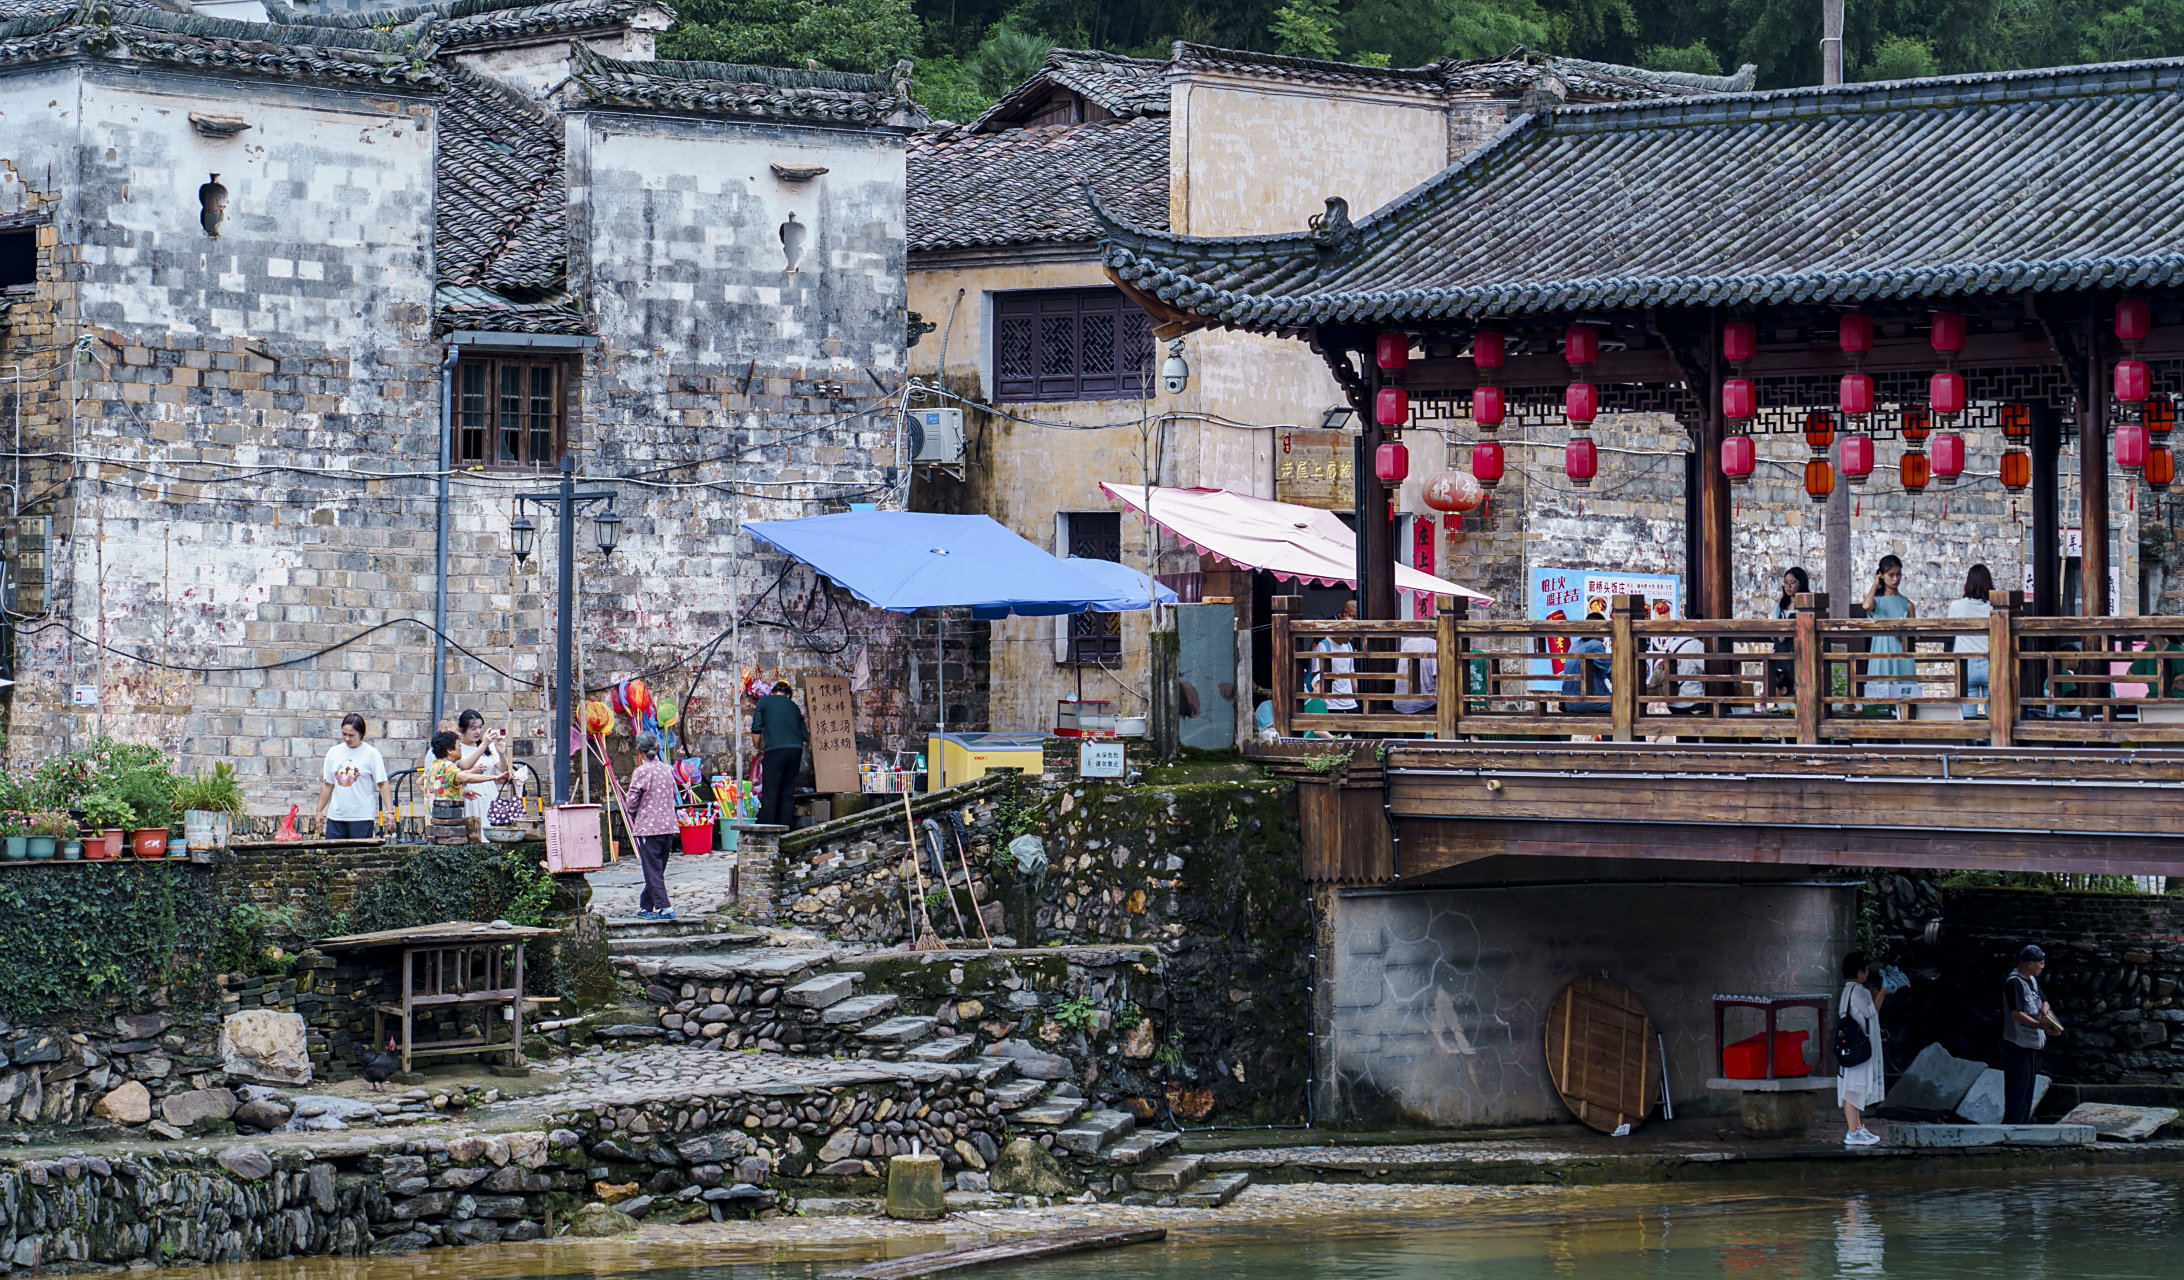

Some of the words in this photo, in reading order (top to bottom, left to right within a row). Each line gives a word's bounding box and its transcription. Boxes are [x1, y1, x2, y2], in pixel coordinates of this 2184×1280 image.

[1541, 576, 1566, 593] 怕上火
[1589, 580, 1626, 595] 廊桥头饭庄
[1546, 588, 1580, 606] 喝王老吉
[819, 683, 843, 698] 饮料
[823, 701, 846, 717] 冰棒
[816, 720, 850, 735] 绿豆汤
[820, 738, 851, 752] 冰凉粉
